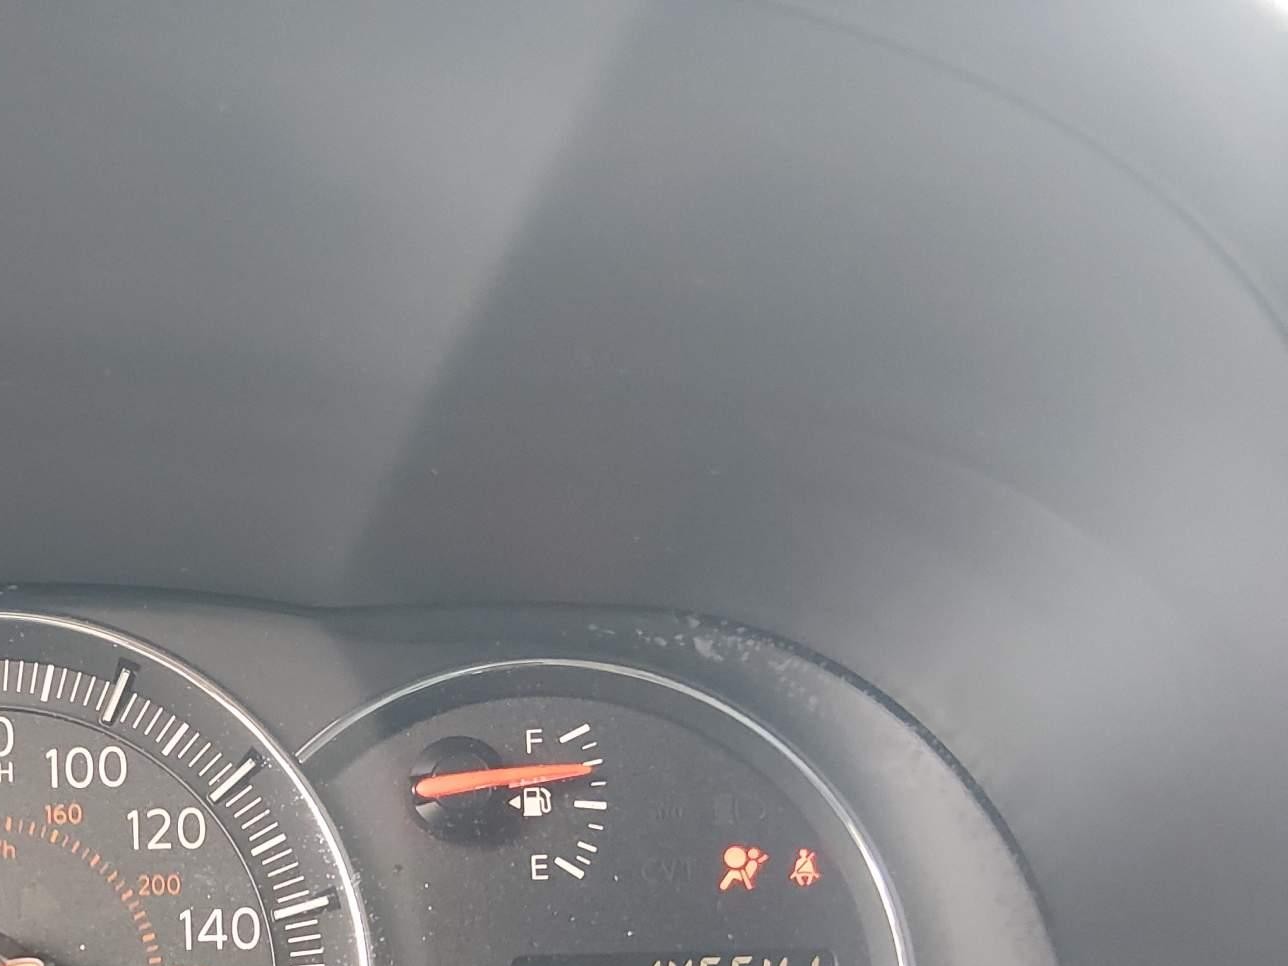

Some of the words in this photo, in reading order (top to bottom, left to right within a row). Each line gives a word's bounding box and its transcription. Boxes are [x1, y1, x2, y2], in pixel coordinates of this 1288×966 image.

[525, 728, 544, 753] F
[45, 746, 128, 788] 100
[44, 804, 83, 826] 160
[127, 808, 206, 850] 120
[530, 855, 549, 880] E
[139, 874, 181, 896] 200
[180, 908, 260, 950] 140
